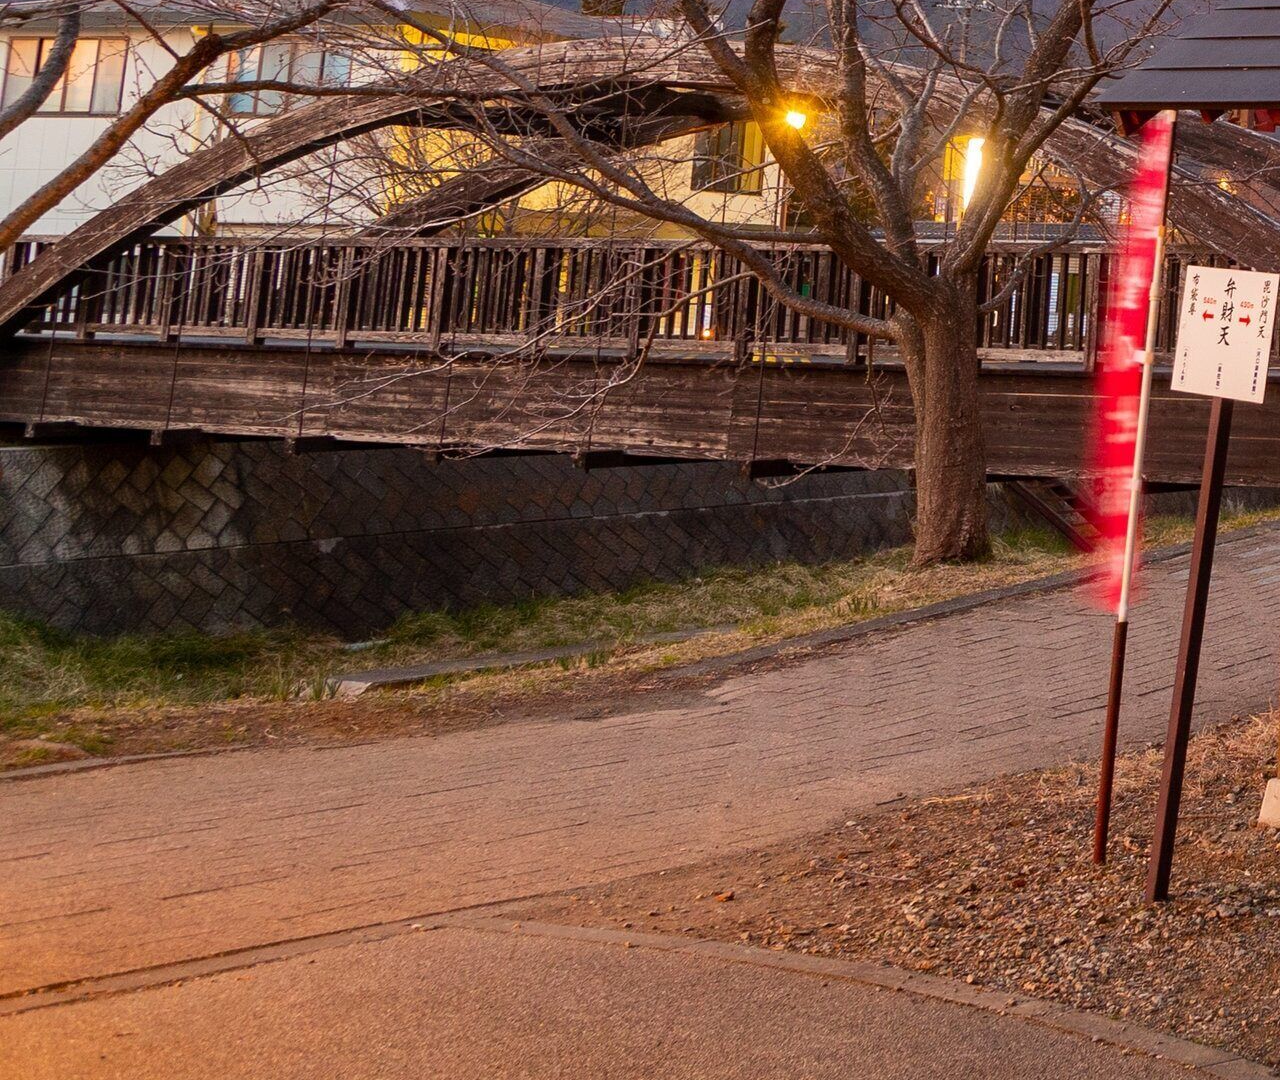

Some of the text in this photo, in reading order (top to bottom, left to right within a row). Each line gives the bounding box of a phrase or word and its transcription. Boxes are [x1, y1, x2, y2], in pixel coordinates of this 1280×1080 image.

[1187, 272, 1200, 315] 布袋尊
[1217, 277, 1237, 346] 弁財天
[1257, 280, 1271, 339] 毘沙門天
